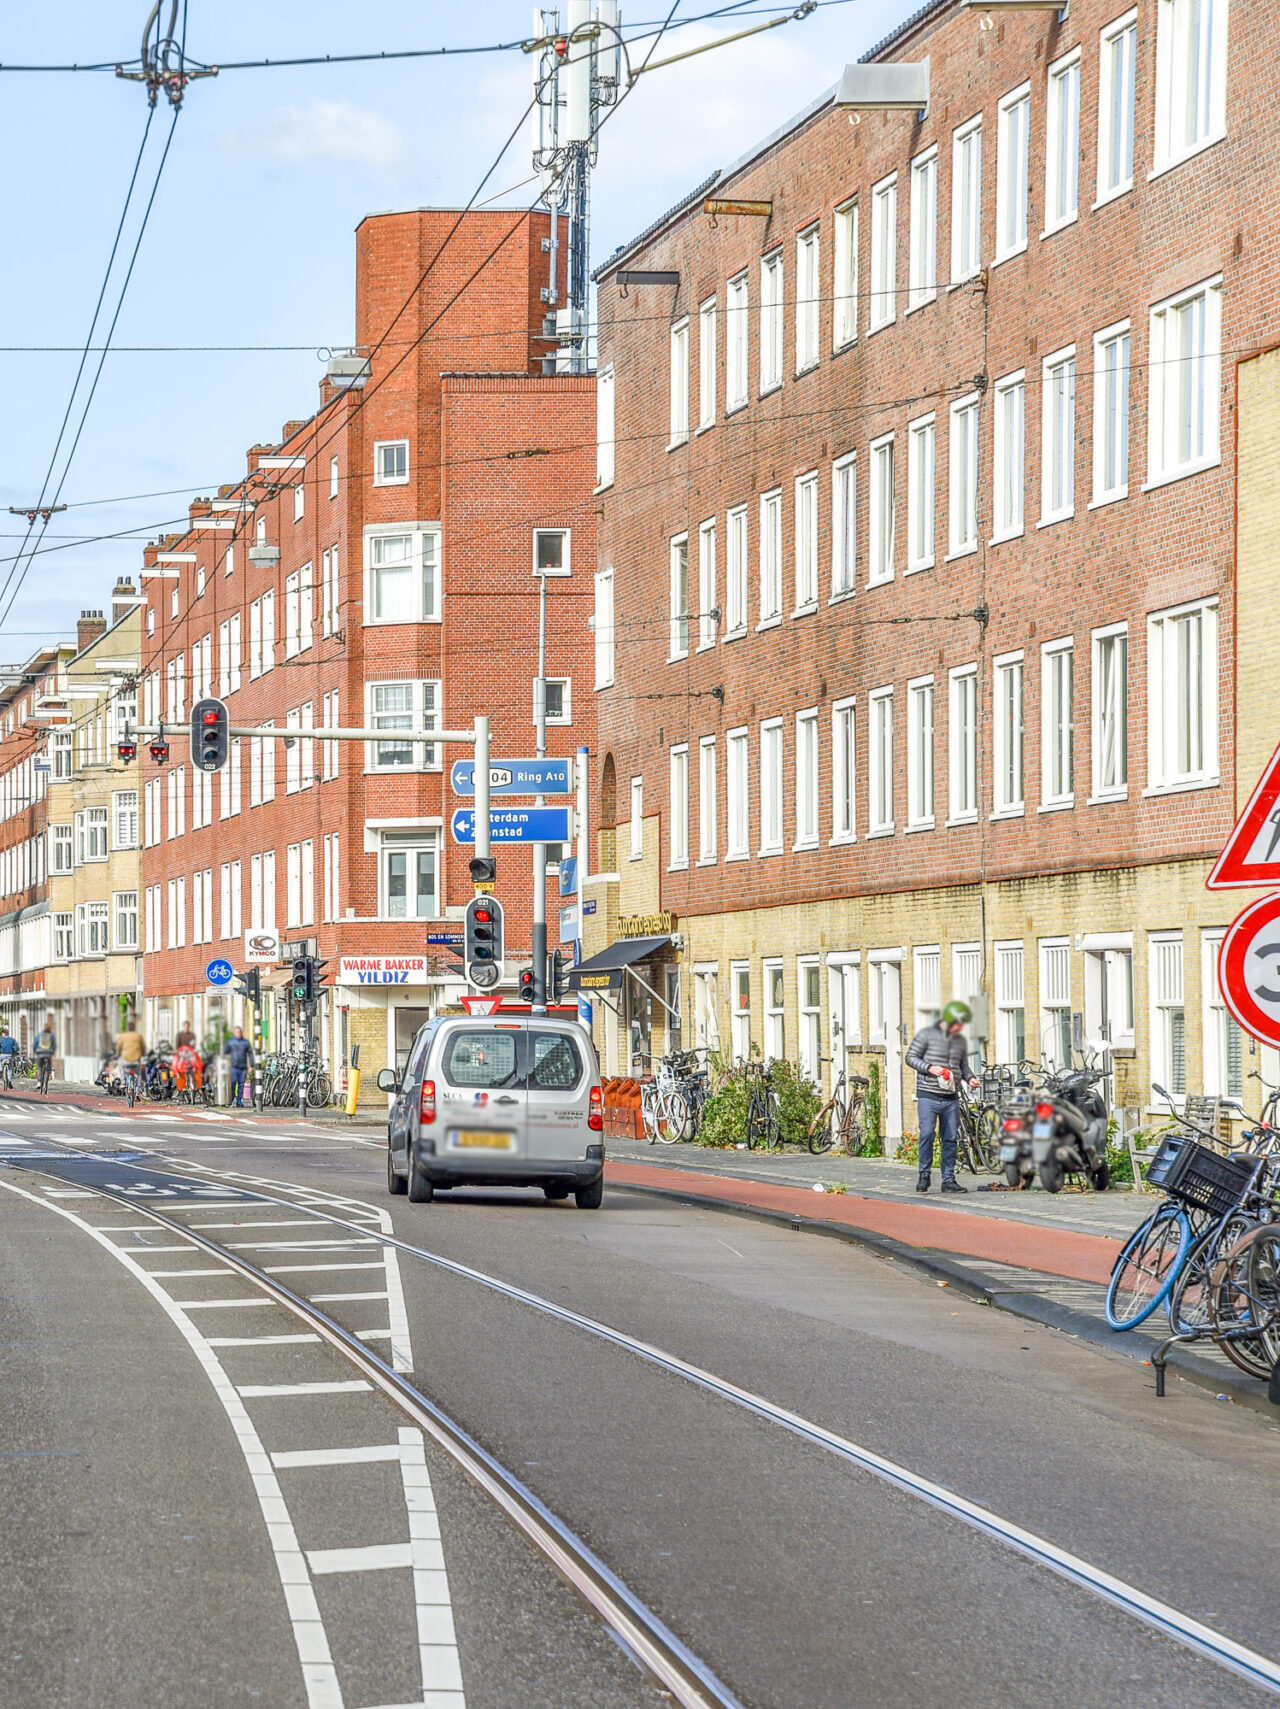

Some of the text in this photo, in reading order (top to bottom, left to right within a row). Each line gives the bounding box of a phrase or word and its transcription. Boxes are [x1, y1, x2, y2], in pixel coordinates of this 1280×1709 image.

[517, 772, 542, 783] Ring
[545, 773, 565, 781] A10
[470, 813, 529, 823] Rterdam
[343, 959, 424, 971] WARME BAKKER
[357, 971, 409, 984] YILDIZ
